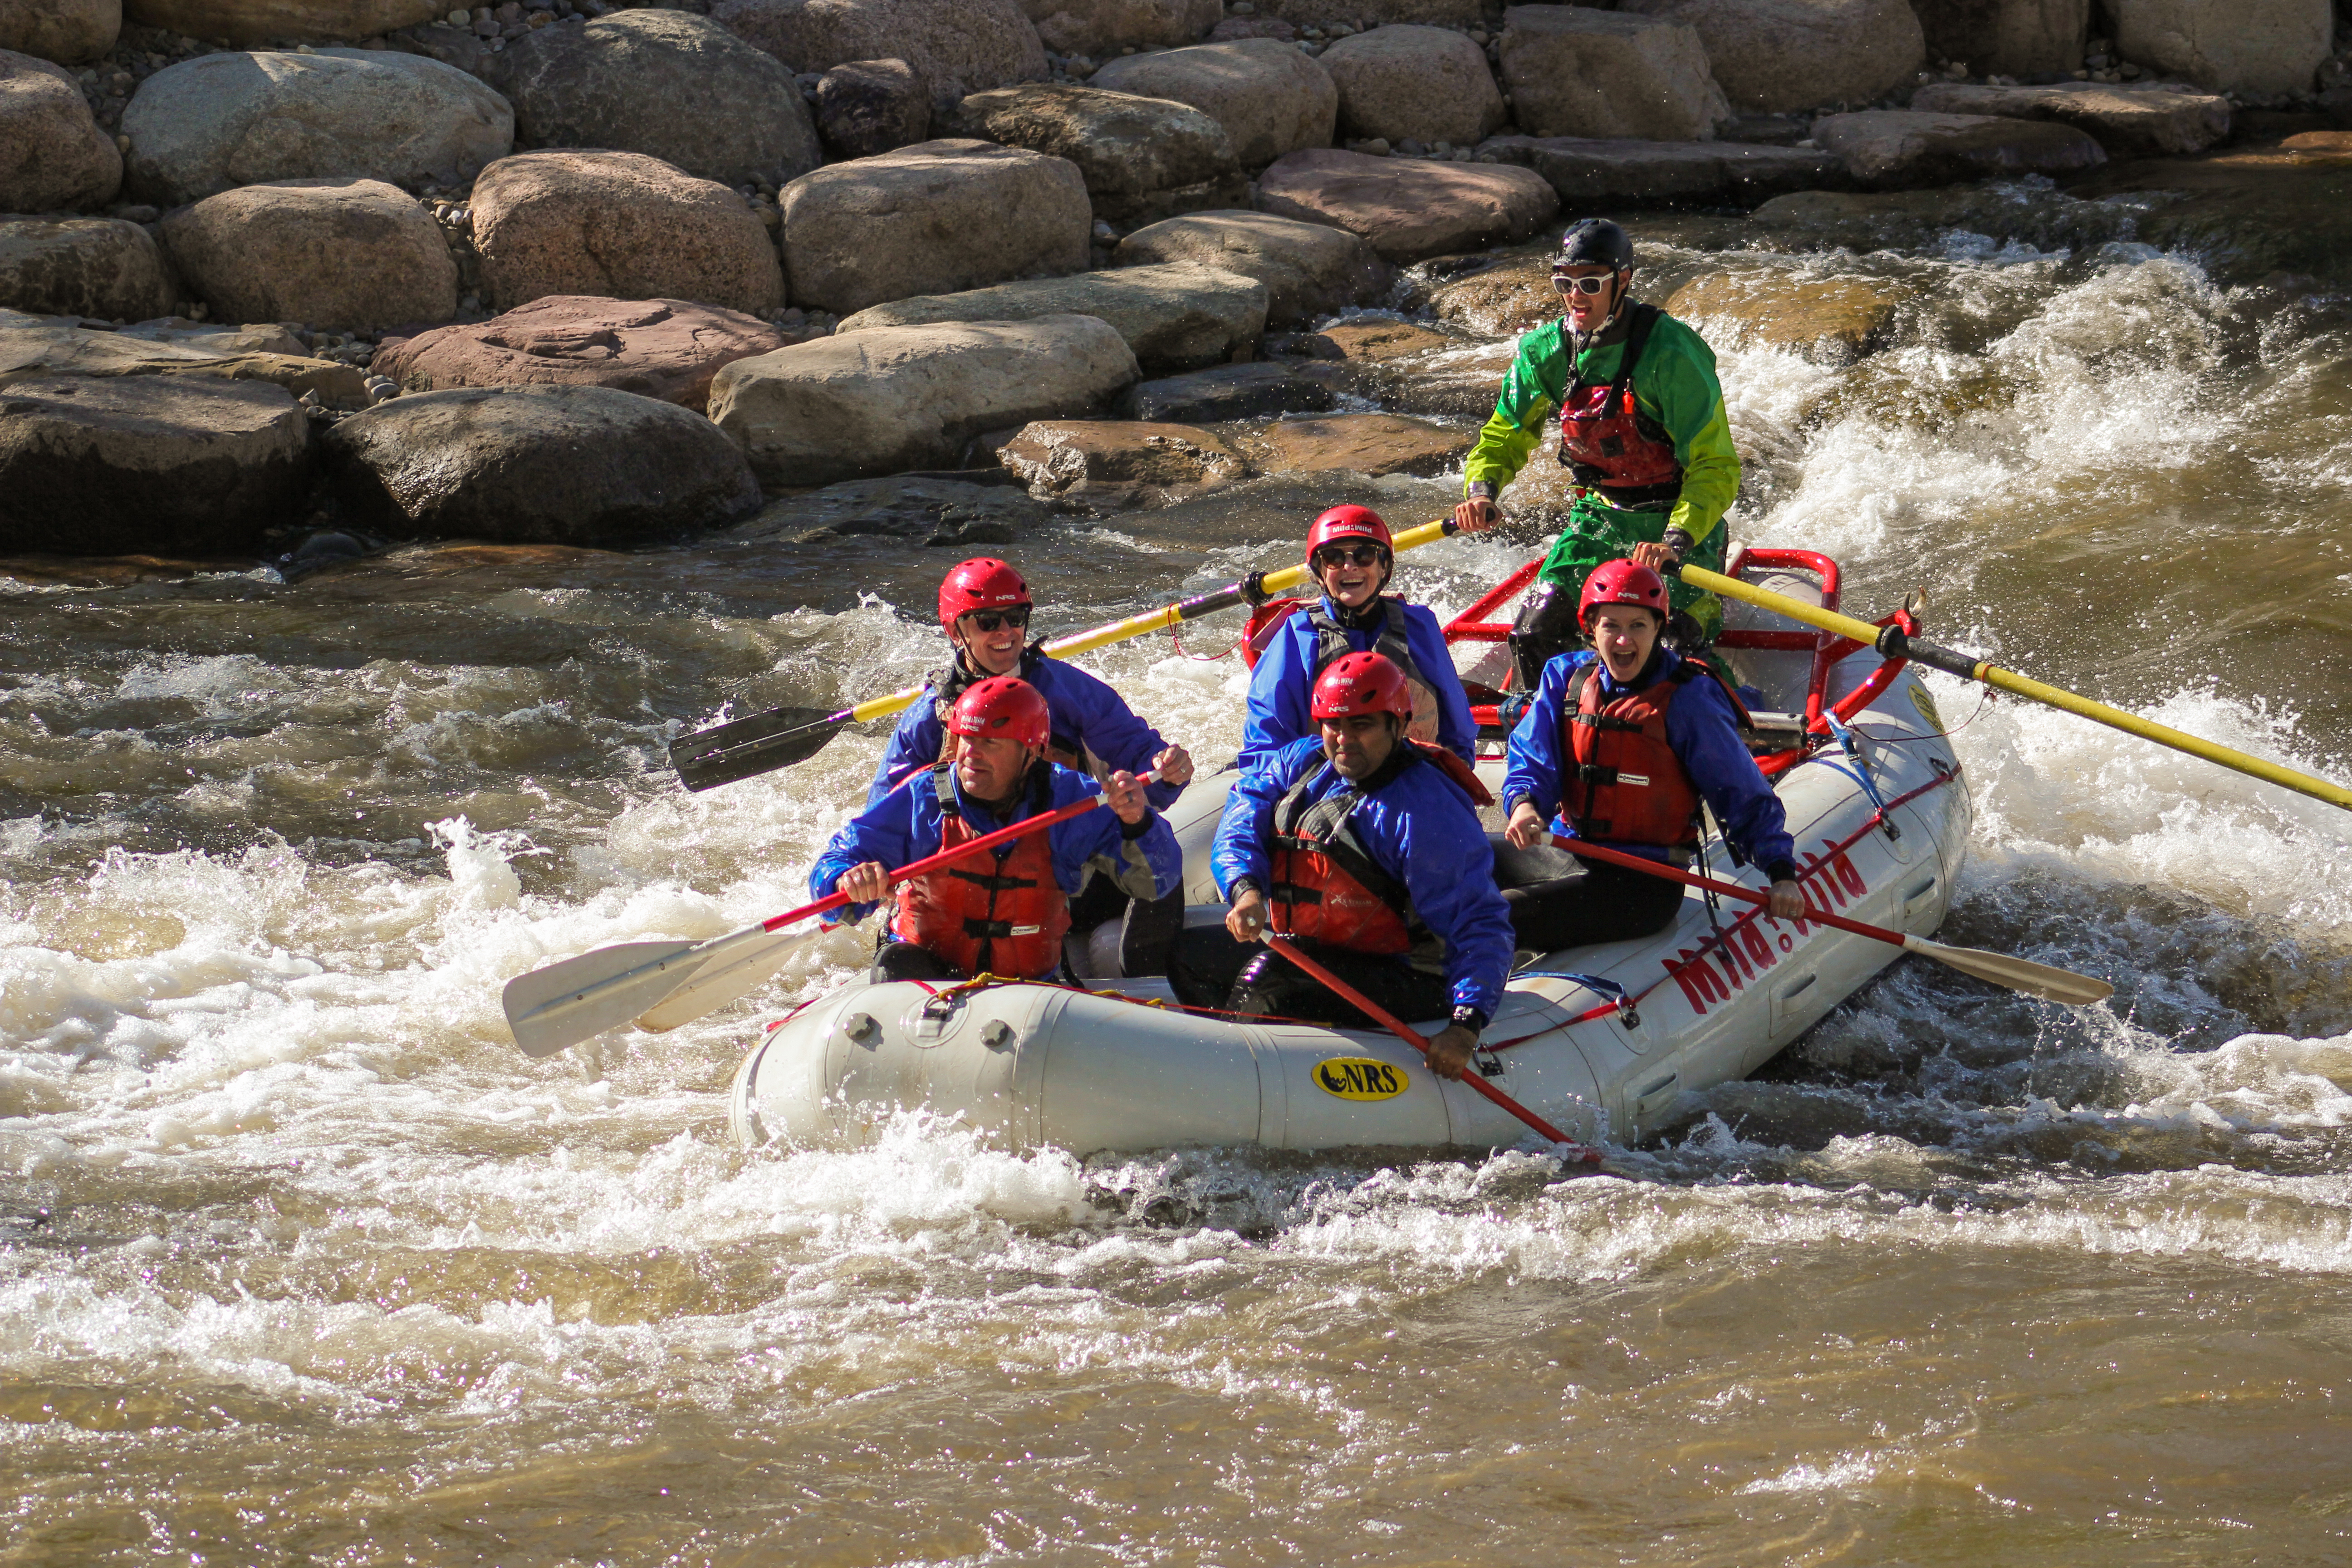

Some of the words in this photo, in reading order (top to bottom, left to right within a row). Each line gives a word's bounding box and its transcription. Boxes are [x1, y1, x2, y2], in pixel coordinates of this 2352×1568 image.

[1333, 524, 1350, 533] Mild
[1355, 525, 1372, 533] Wild
[1661, 910, 1777, 1014] Mild
[1341, 1064, 1397, 1093] NRS
